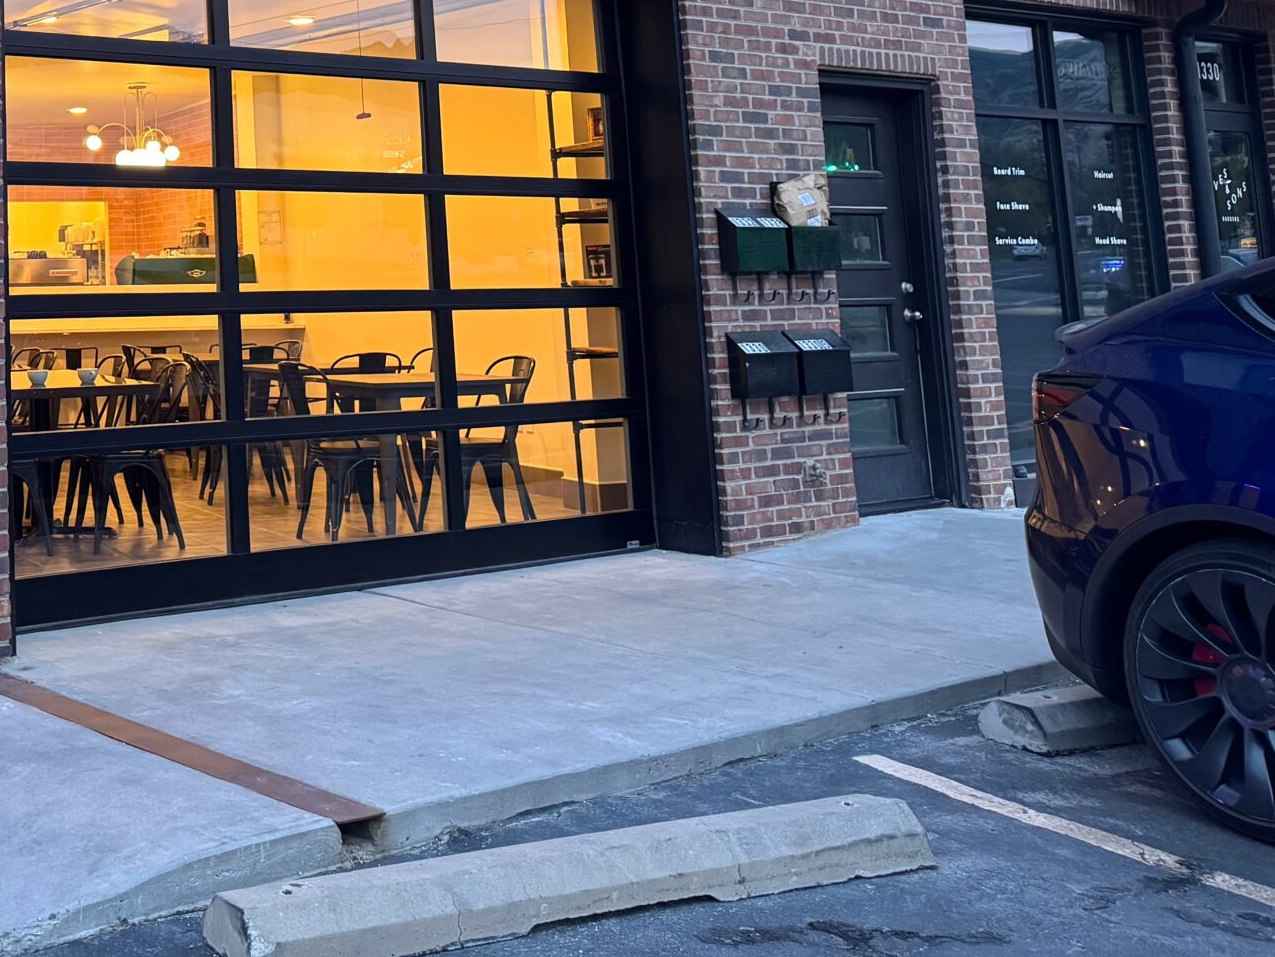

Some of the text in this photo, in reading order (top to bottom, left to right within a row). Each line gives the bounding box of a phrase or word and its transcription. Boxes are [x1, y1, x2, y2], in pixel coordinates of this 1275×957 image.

[1012, 167, 1026, 176] Trim
[1093, 170, 1114, 179] Haircut
[995, 236, 1017, 245] Service
